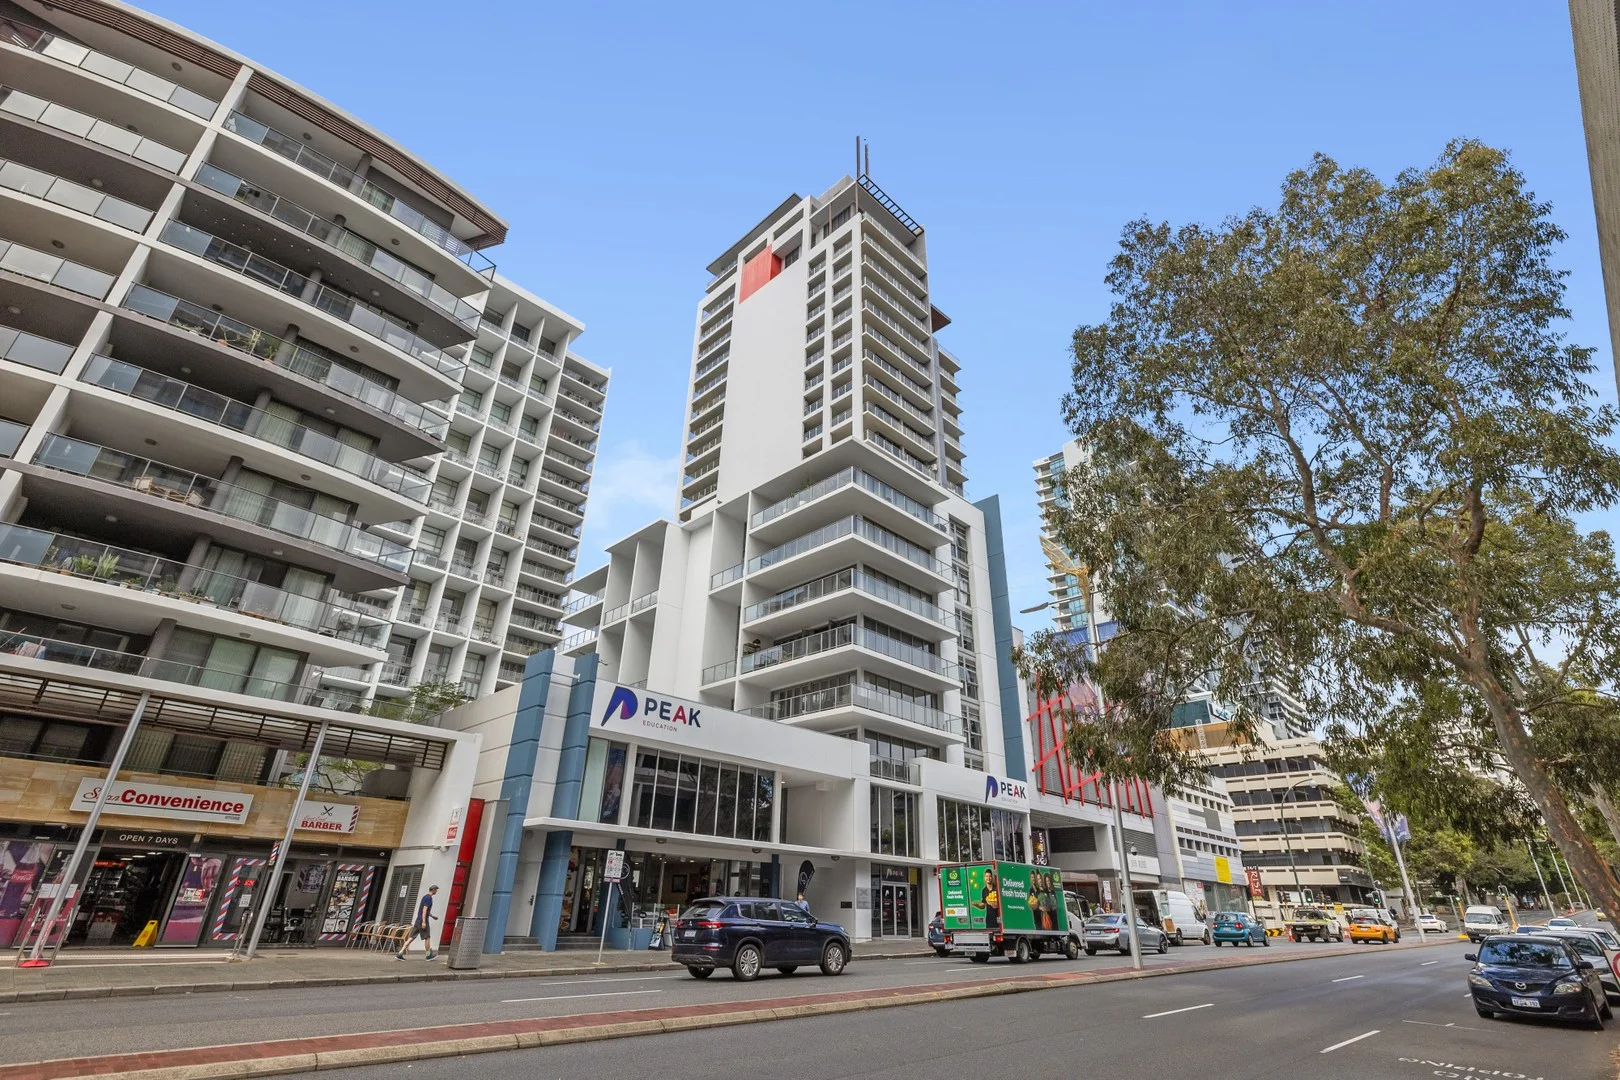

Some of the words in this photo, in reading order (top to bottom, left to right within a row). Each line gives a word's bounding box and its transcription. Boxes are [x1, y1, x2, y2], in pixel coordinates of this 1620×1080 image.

[644, 697, 702, 728] PEAK
[643, 720, 678, 732] EDUCATION
[1000, 781, 1027, 800] PEAK
[83, 786, 120, 802] San
[121, 789, 245, 813] Convenience
[301, 821, 342, 831] BARBER
[119, 834, 145, 843] OPEN
[155, 836, 179, 845] DAYS
[1002, 878, 1025, 888] Delivered
[1001, 888, 1015, 897] fresh
[1014, 890, 1028, 901] today
